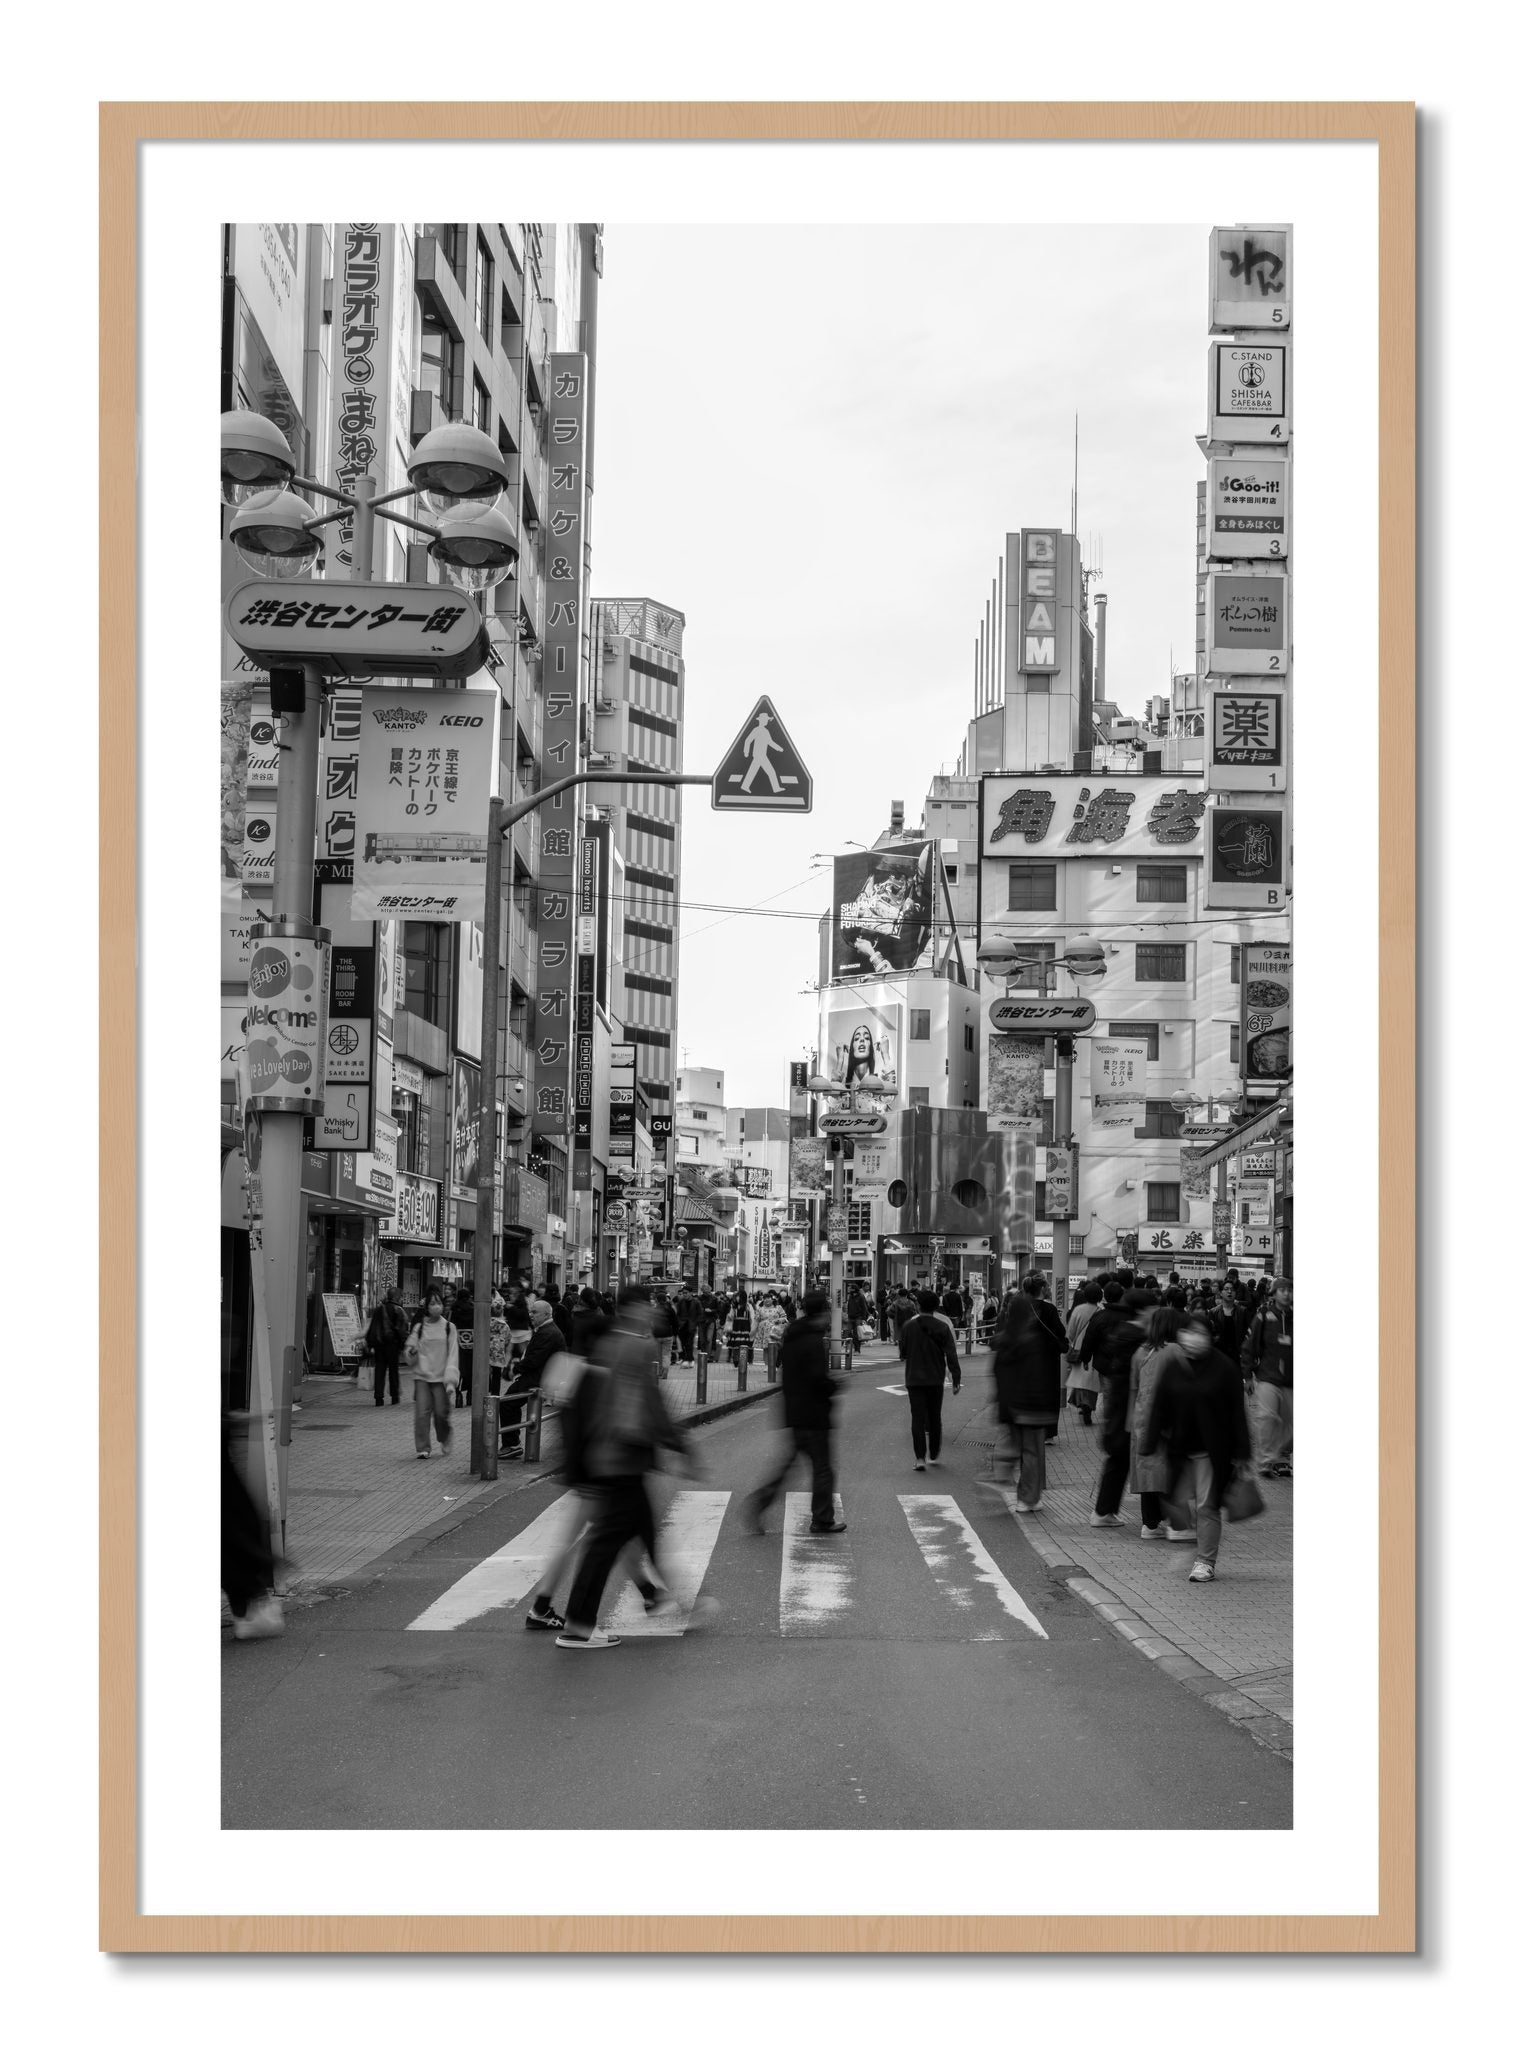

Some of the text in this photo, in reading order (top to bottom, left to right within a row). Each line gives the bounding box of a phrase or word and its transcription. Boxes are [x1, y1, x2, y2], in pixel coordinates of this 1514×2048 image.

[342, 229, 381, 359] カラオケ
[1271, 309, 1283, 323] 5
[1231, 352, 1273, 361] C.STAND
[1231, 390, 1273, 399] SHISHA
[1231, 399, 1272, 407] CAFE&BAR
[1271, 424, 1282, 438] 4
[1219, 519, 1281, 530] 全身もみほぐし
[1270, 540, 1280, 554] 3
[1025, 534, 1055, 665] BEAM
[239, 599, 467, 634] 渋谷センター街
[1220, 605, 1278, 622] ポムの樹
[1269, 656, 1280, 670] 2
[439, 715, 484, 728] KEIO
[1223, 700, 1269, 746] 薬
[389, 747, 403, 787] 冒険へ
[444, 748, 459, 803] 京王線で
[405, 747, 421, 816] カントーの
[424, 747, 441, 816] ポケパーク
[1269, 773, 1276, 787] 1
[990, 787, 1208, 843] 角海老
[1218, 824, 1273, 867] 一蘭
[584, 841, 593, 875] kimono
[377, 896, 459, 909] 渋谷センター街
[1267, 890, 1278, 904] B
[252, 959, 288, 990] Enjoy
[537, 893, 568, 1115] カラオケ館
[995, 1006, 1090, 1019] 渋谷センター街
[248, 1005, 317, 1028] Welcome
[1247, 1015, 1273, 1032] 6F
[263, 1058, 291, 1076] Lovely
[292, 1059, 310, 1072] Day!
[323, 1126, 342, 1135] Bank
[324, 1118, 355, 1128] Whisky
[652, 1121, 671, 1131] GU
